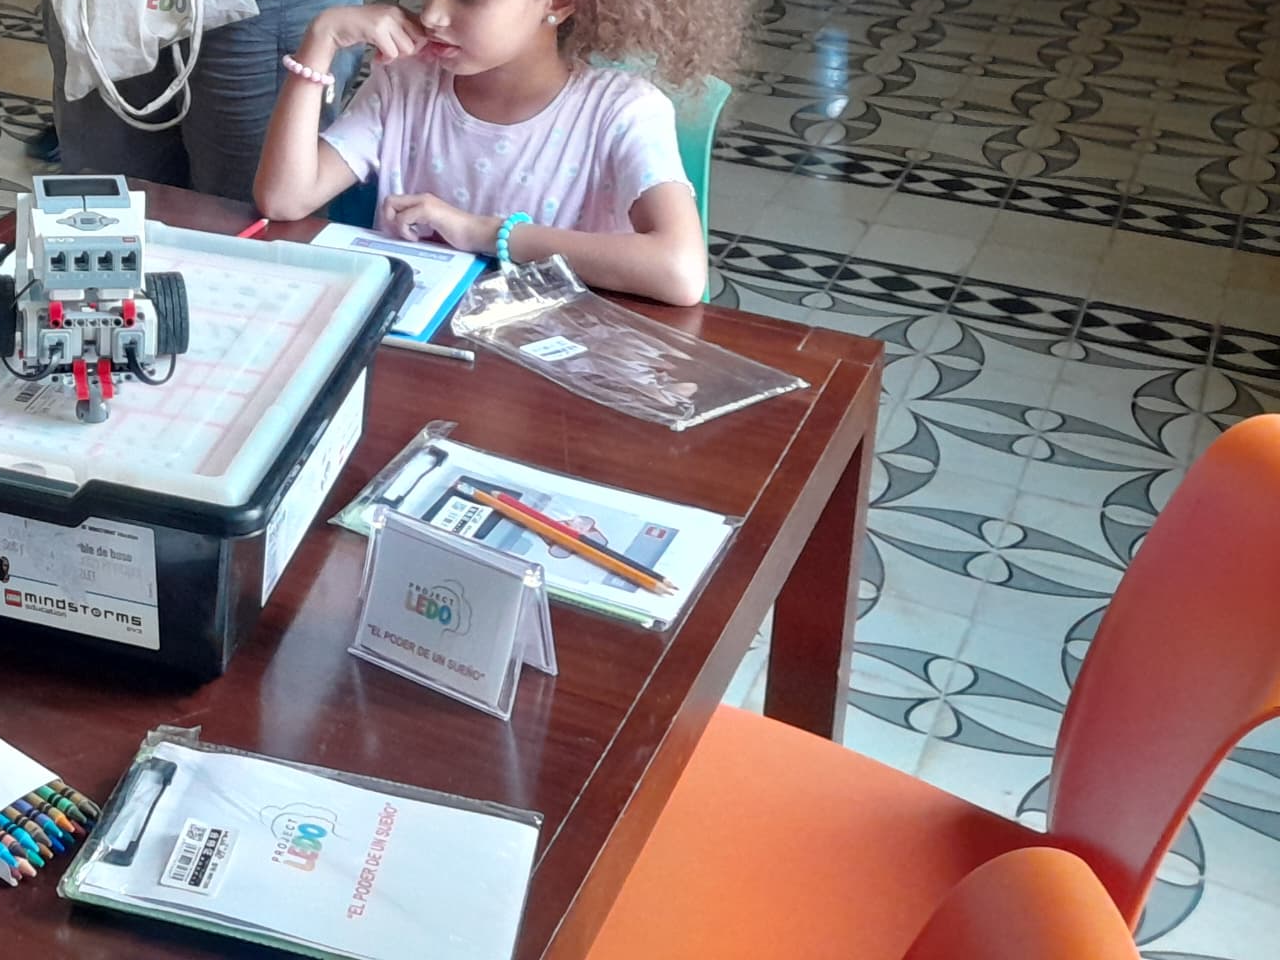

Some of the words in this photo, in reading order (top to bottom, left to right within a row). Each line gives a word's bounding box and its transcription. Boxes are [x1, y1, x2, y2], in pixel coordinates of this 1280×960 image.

[404, 590, 453, 625] LEDO
[407, 582, 455, 606] PROJECT
[383, 631, 417, 655] PODER
[417, 645, 431, 661] DE
[432, 651, 446, 667] UN
[271, 818, 298, 863] PROJECT
[283, 823, 328, 872] LEDO
[370, 836, 389, 853] UN
[364, 851, 383, 869] DE
[352, 867, 380, 902] PODER
